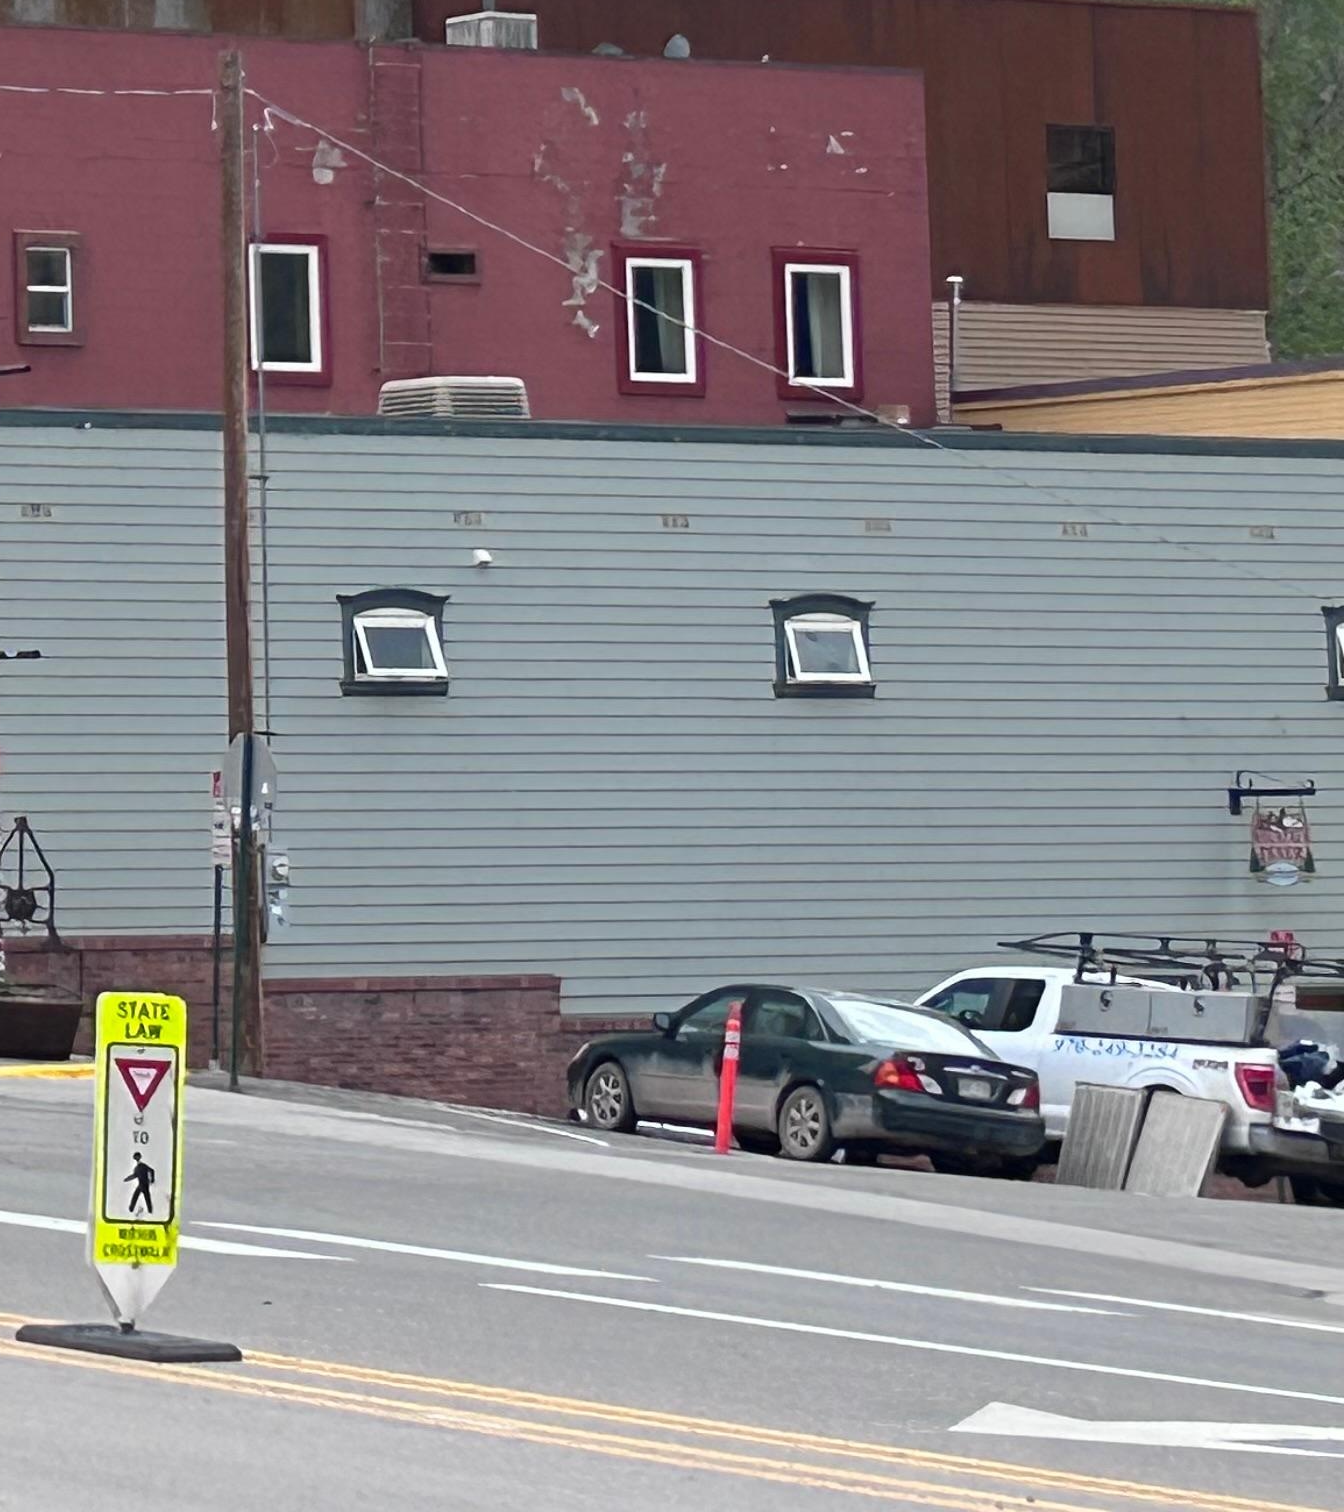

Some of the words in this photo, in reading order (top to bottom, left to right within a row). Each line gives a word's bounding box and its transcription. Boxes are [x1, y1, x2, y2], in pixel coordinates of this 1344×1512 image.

[116, 1000, 171, 1021] STATE
[124, 1022, 164, 1040] LAW
[132, 1130, 150, 1145] TO
